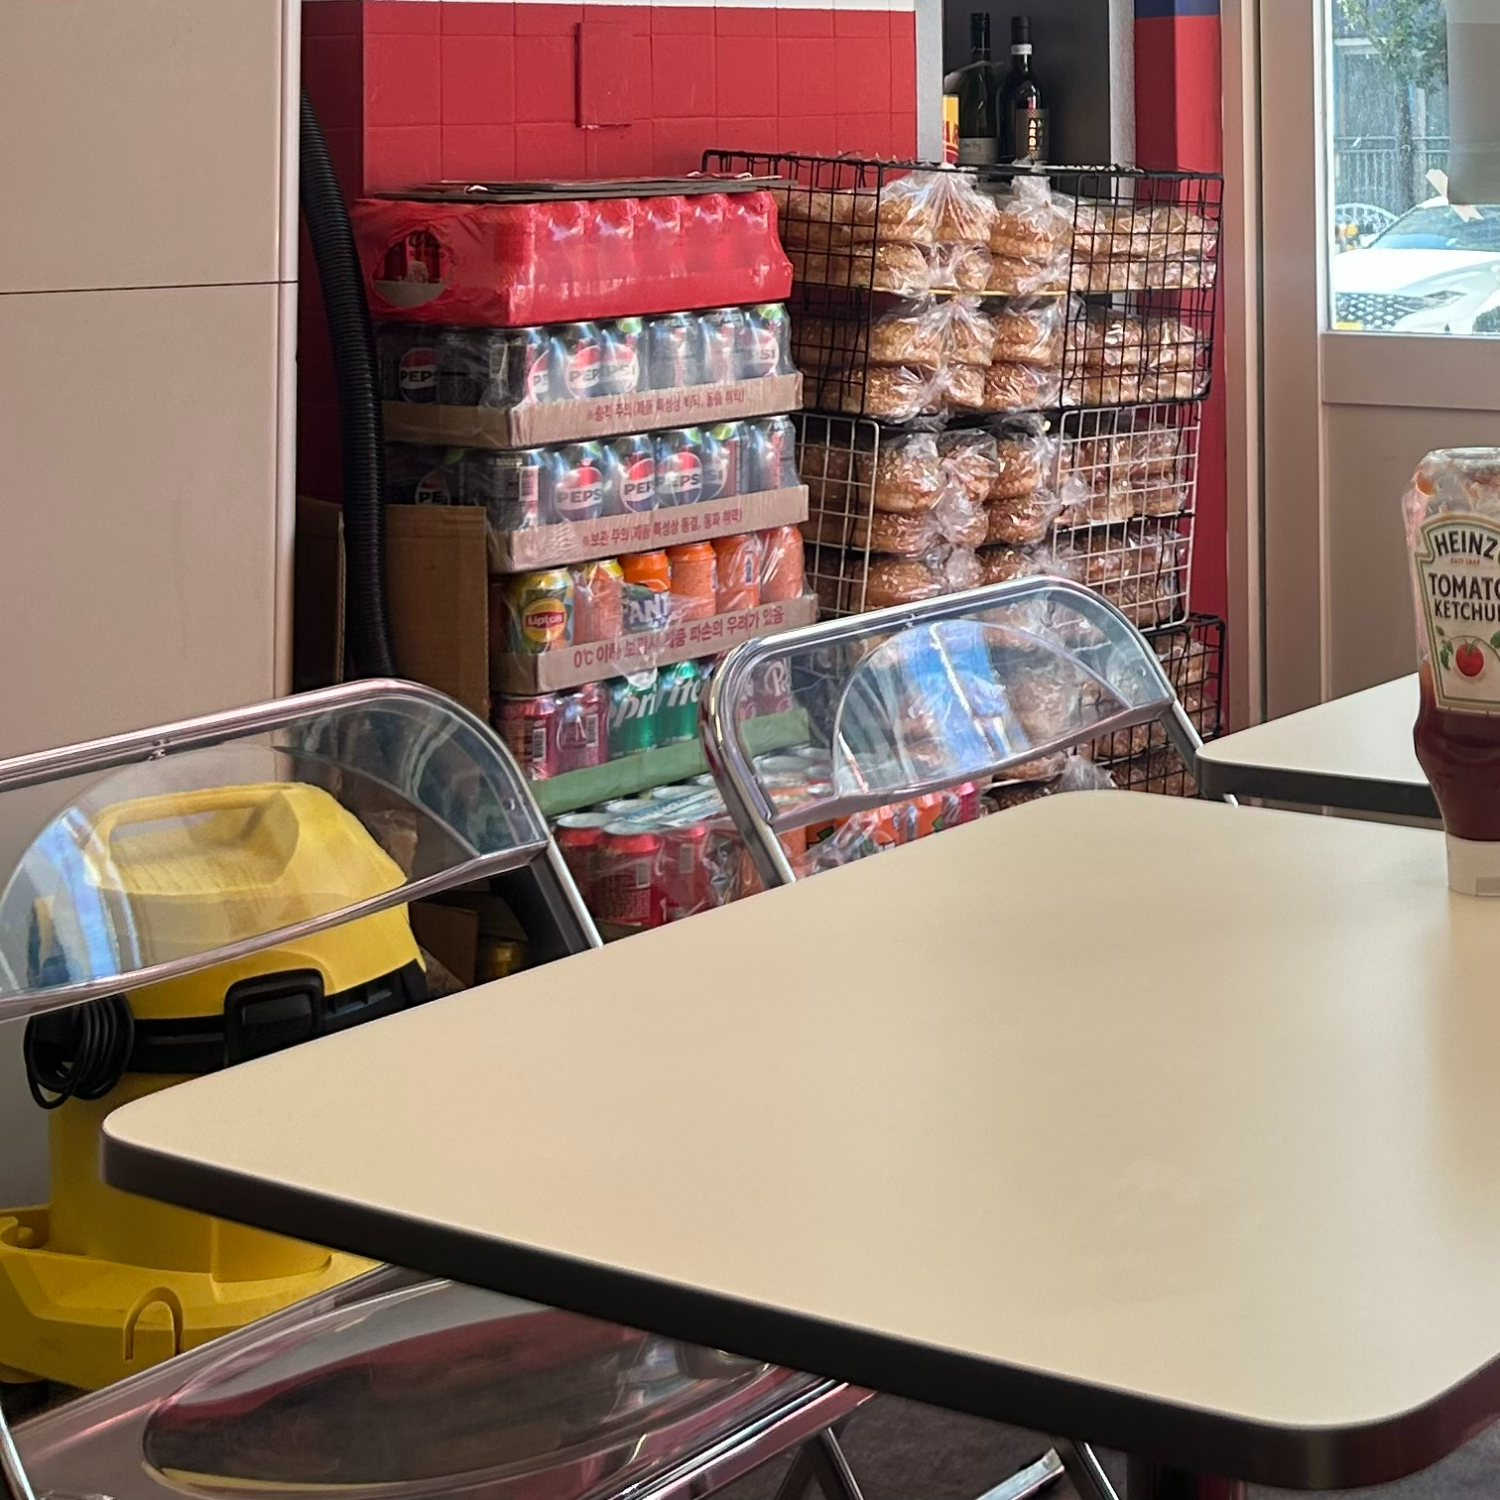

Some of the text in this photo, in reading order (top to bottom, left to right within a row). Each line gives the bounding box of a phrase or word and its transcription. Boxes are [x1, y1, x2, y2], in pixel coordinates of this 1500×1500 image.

[1434, 530, 1498, 560] HEINZ
[526, 611, 566, 628] Lipton
[690, 622, 723, 642] 파손의
[726, 610, 759, 635] 우려가
